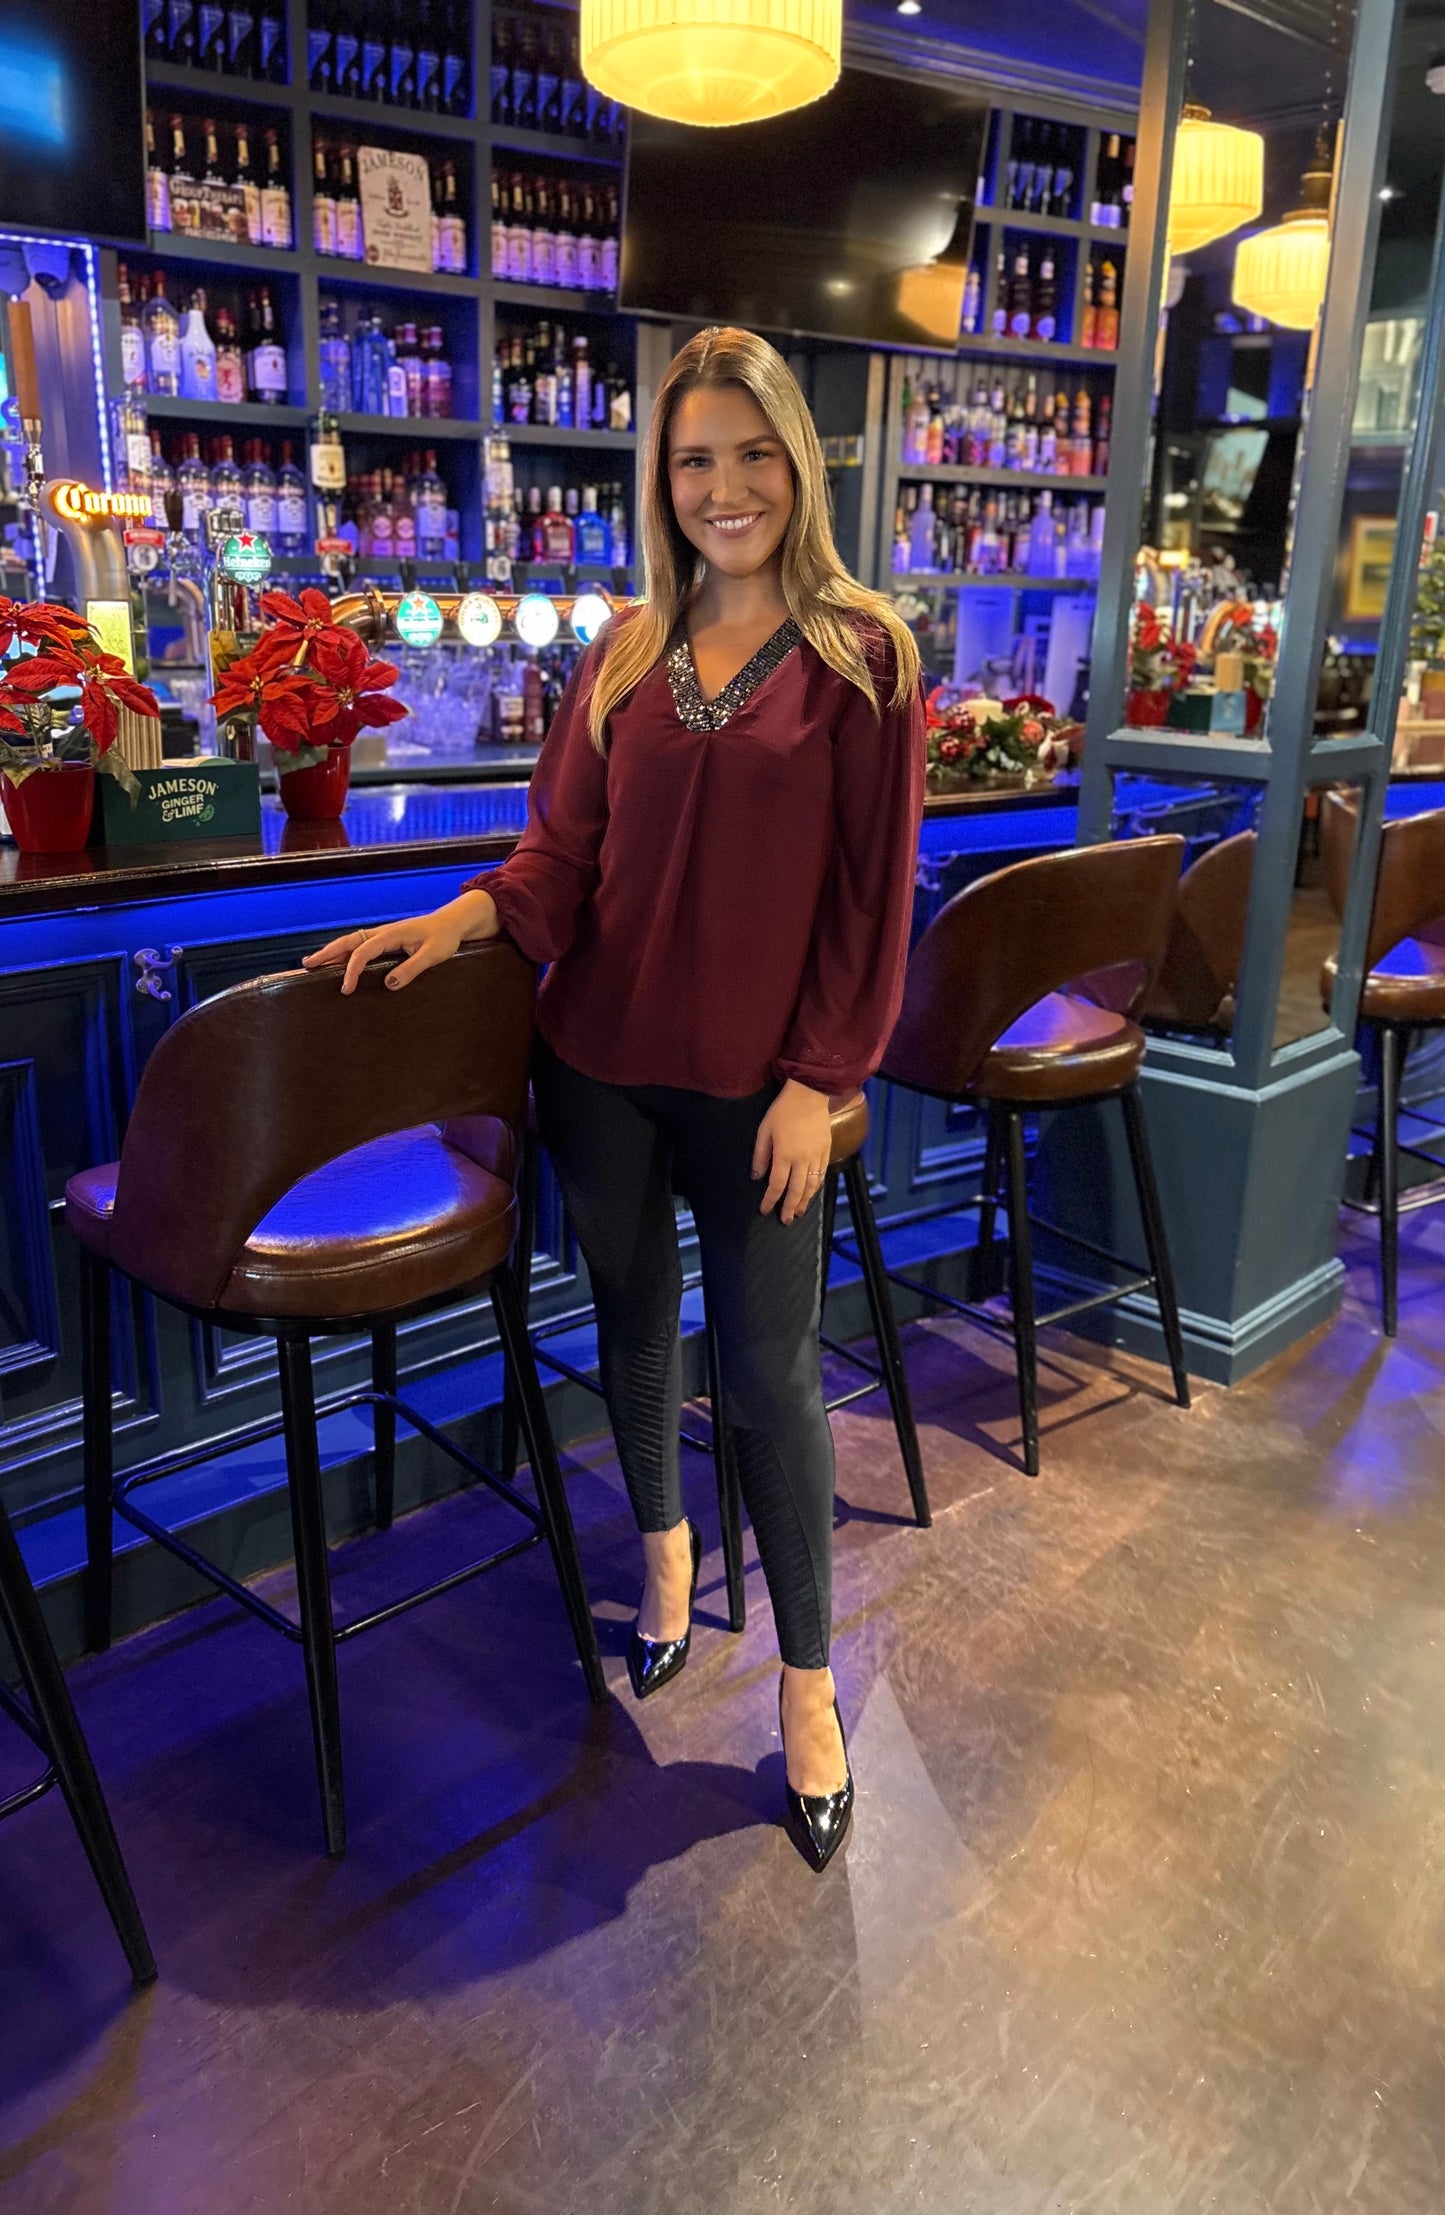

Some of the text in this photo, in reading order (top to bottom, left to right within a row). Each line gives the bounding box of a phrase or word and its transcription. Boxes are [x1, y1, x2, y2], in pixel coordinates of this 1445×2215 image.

[363, 151, 425, 182] JAMESON
[56, 483, 152, 523] Corona
[223, 555, 271, 569] Heineken
[148, 778, 217, 800] JAMESON
[161, 793, 204, 809] GINGER
